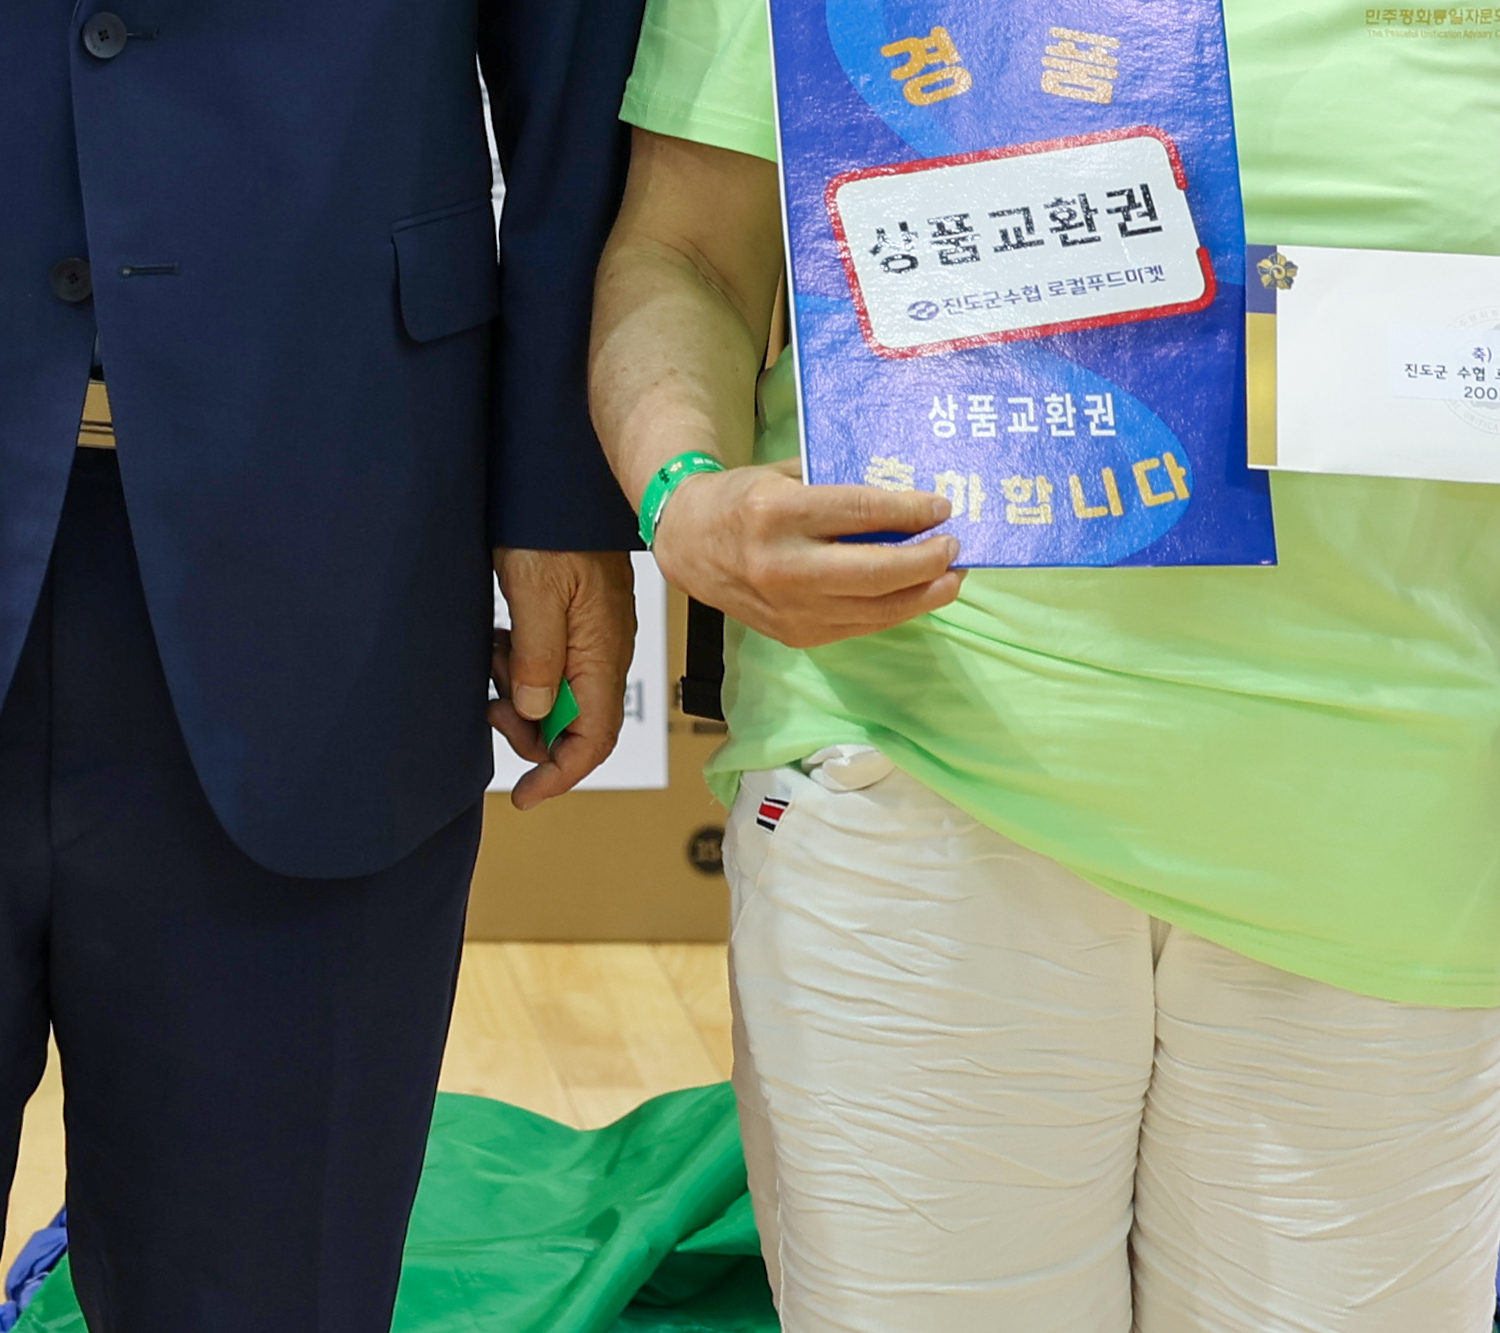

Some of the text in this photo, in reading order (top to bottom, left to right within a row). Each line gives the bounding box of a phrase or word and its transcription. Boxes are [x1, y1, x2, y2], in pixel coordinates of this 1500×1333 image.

[867, 182, 1163, 275] 상품교환권
[941, 263, 1167, 317] 진도군수협 로컬푸드마켓
[1404, 363, 1448, 380] 진도군
[1456, 366, 1485, 382] 수협
[927, 392, 1117, 438] 상품교환권
